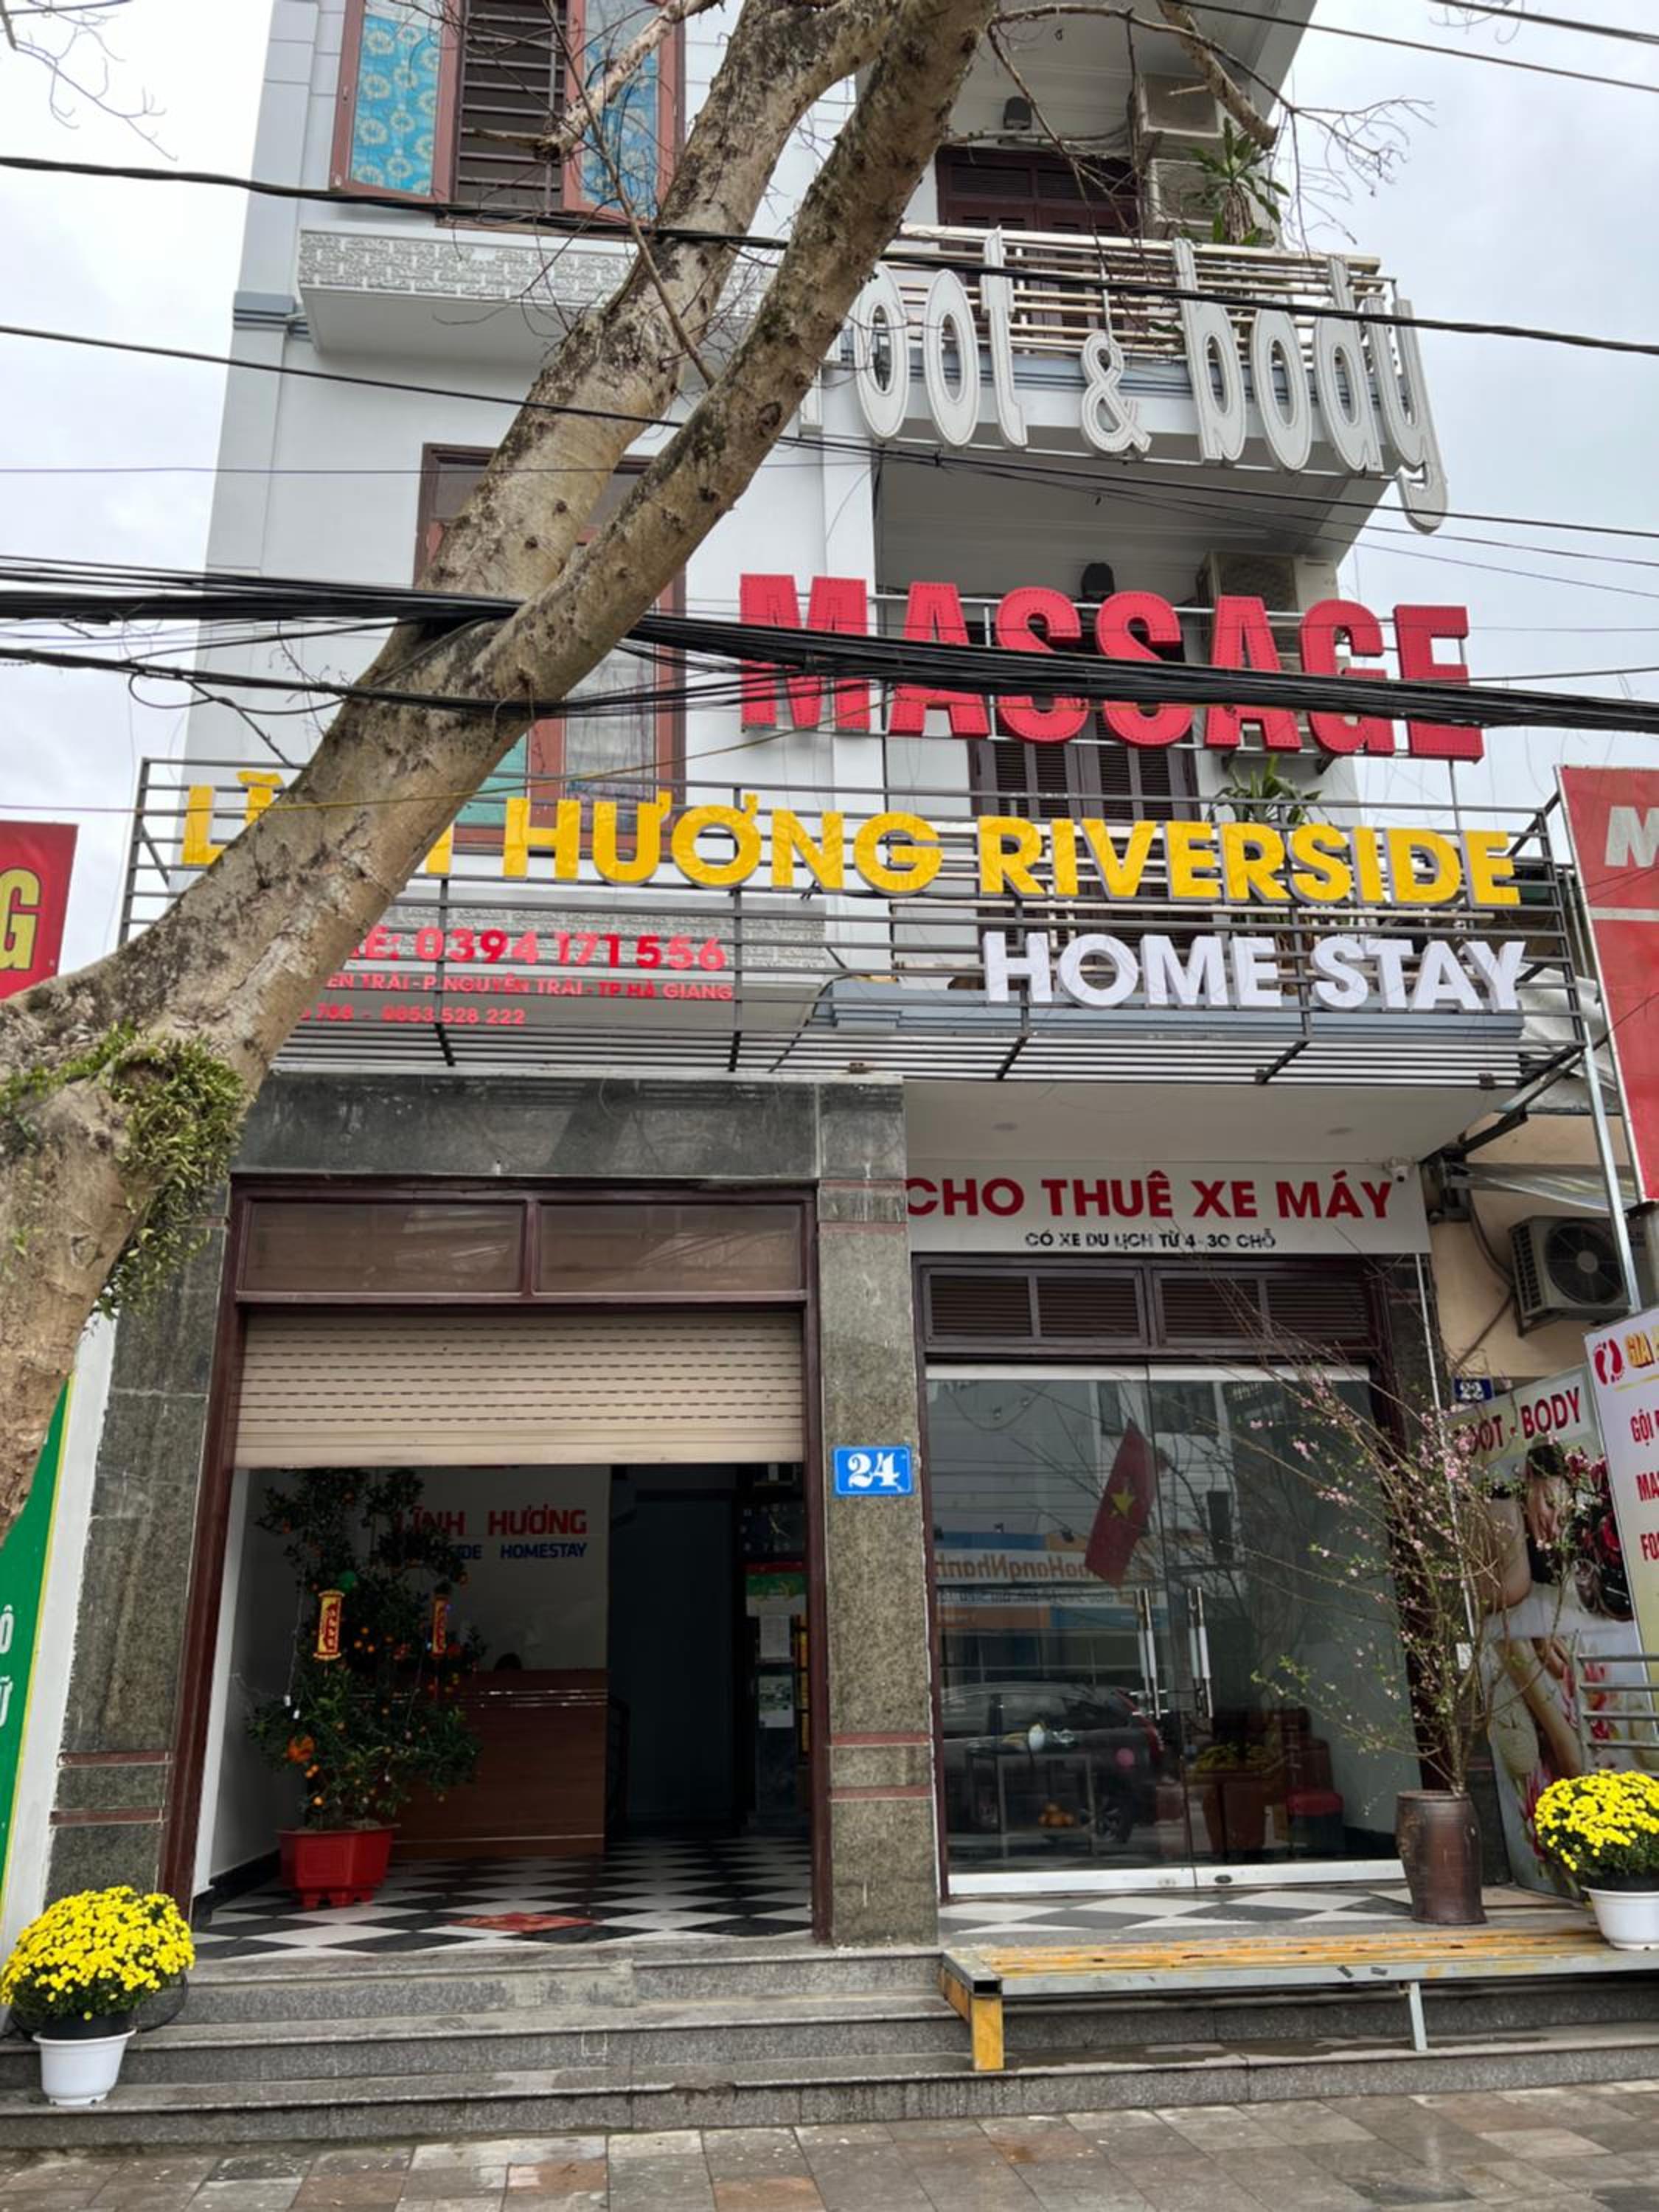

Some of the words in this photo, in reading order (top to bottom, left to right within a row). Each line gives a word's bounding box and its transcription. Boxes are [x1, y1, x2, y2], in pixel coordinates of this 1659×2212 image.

[800, 226, 1029, 448] oot
[1080, 330, 1152, 457] &
[1173, 237, 1450, 534] body
[740, 573, 1484, 762] MASSAGE
[502, 790, 943, 896] HƯƠNG
[977, 815, 1521, 906] RIVERSIDE
[414, 927, 539, 965] 0394
[663, 981, 733, 1001] GIANG
[982, 931, 1284, 1009] HOME
[1310, 937, 1526, 1013] STAY
[442, 1008, 478, 1024] 528
[487, 1009, 526, 1026] 222
[906, 1177, 1024, 1216] CHO
[1042, 1169, 1173, 1217] THUÊ
[1192, 1181, 1258, 1218] XE
[1276, 1169, 1393, 1218] MÁY
[1059, 1232, 1081, 1247] XE
[1520, 1385, 1580, 1439] BODY
[848, 1453, 901, 1488] 24
[487, 1503, 588, 1536] HƯƠNG
[501, 1542, 588, 1559] HOMESTAY
